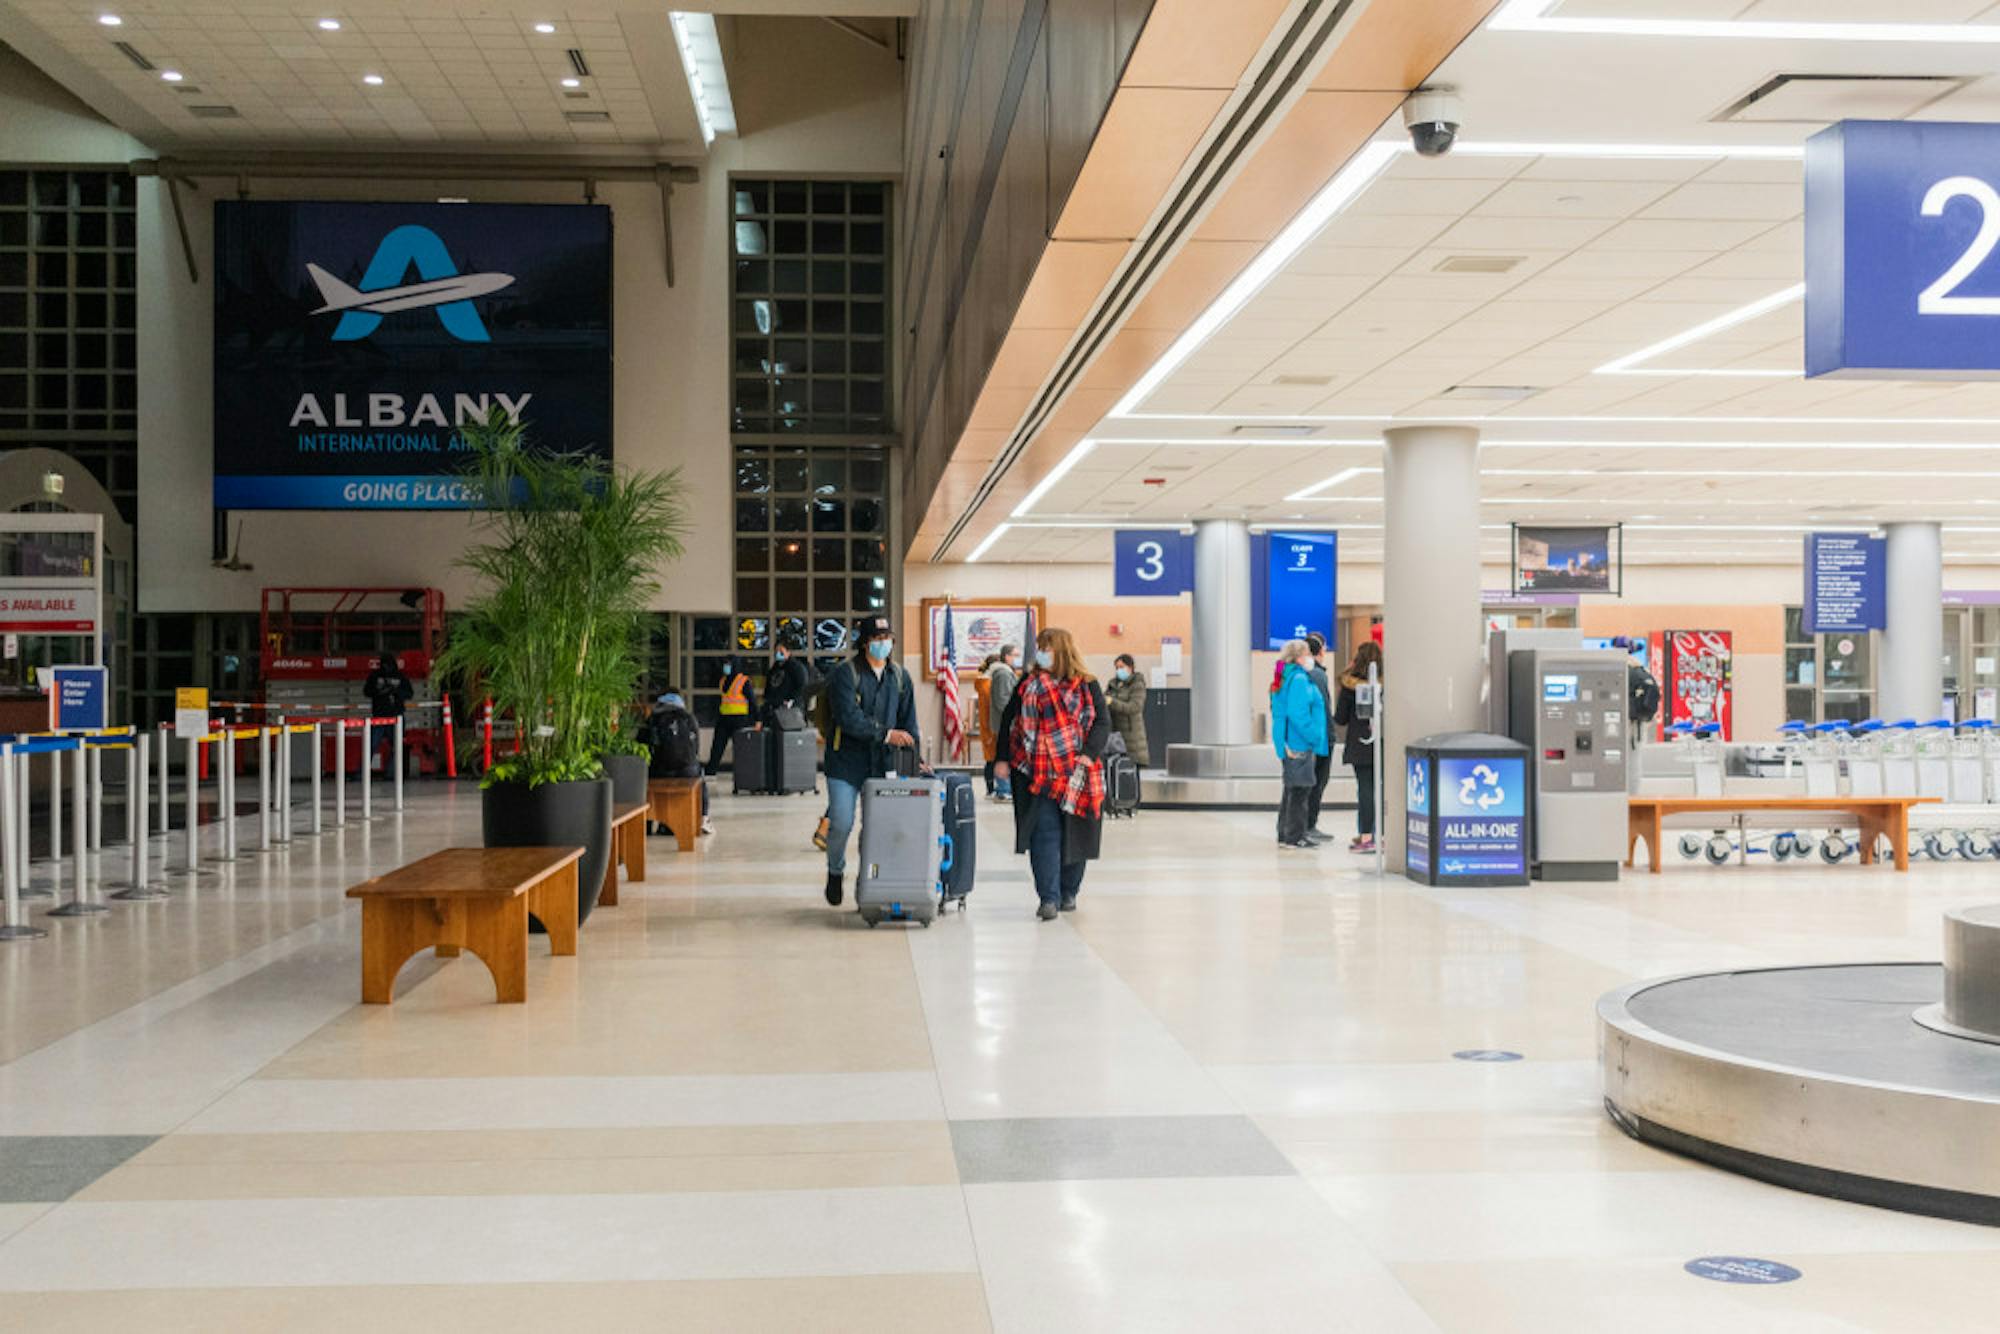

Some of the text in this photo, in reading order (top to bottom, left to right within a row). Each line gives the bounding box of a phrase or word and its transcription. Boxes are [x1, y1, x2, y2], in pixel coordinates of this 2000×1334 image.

[1918, 176, 2000, 315] 2
[289, 393, 532, 428] ALBANY
[299, 433, 526, 451] INTERNATIONAL AIPOT
[343, 482, 408, 502] GOING
[1136, 541, 1165, 581] 3
[1296, 553, 1308, 567] 3
[13, 599, 77, 611] AVAILABLE
[1445, 823, 1519, 838] ALL-IN-ONE
